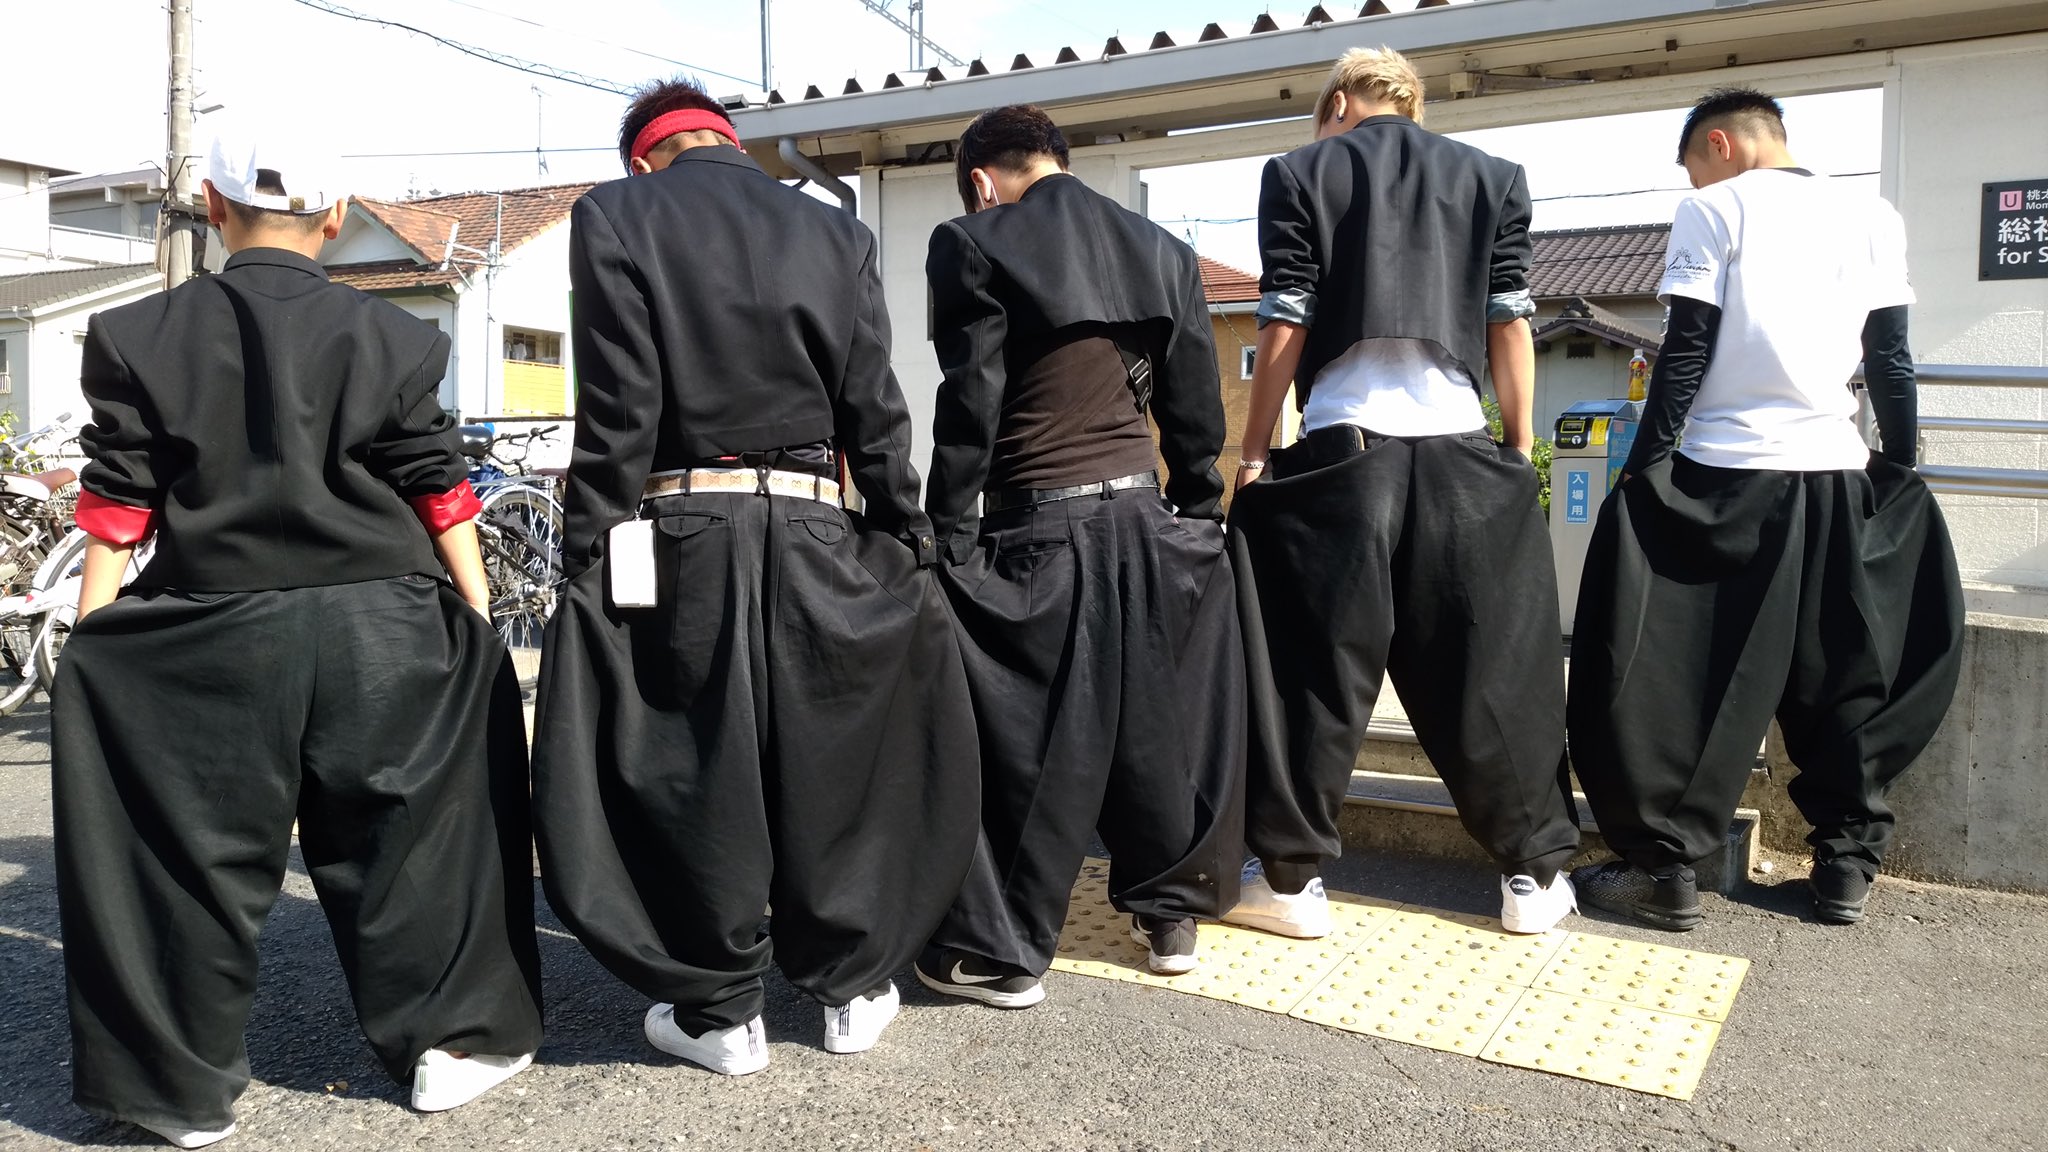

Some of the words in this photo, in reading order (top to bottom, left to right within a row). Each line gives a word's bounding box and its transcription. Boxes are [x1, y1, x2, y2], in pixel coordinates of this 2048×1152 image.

[2004, 193, 2018, 208] U
[1997, 247, 2032, 264] for
[1571, 473, 1585, 516] 入場用
